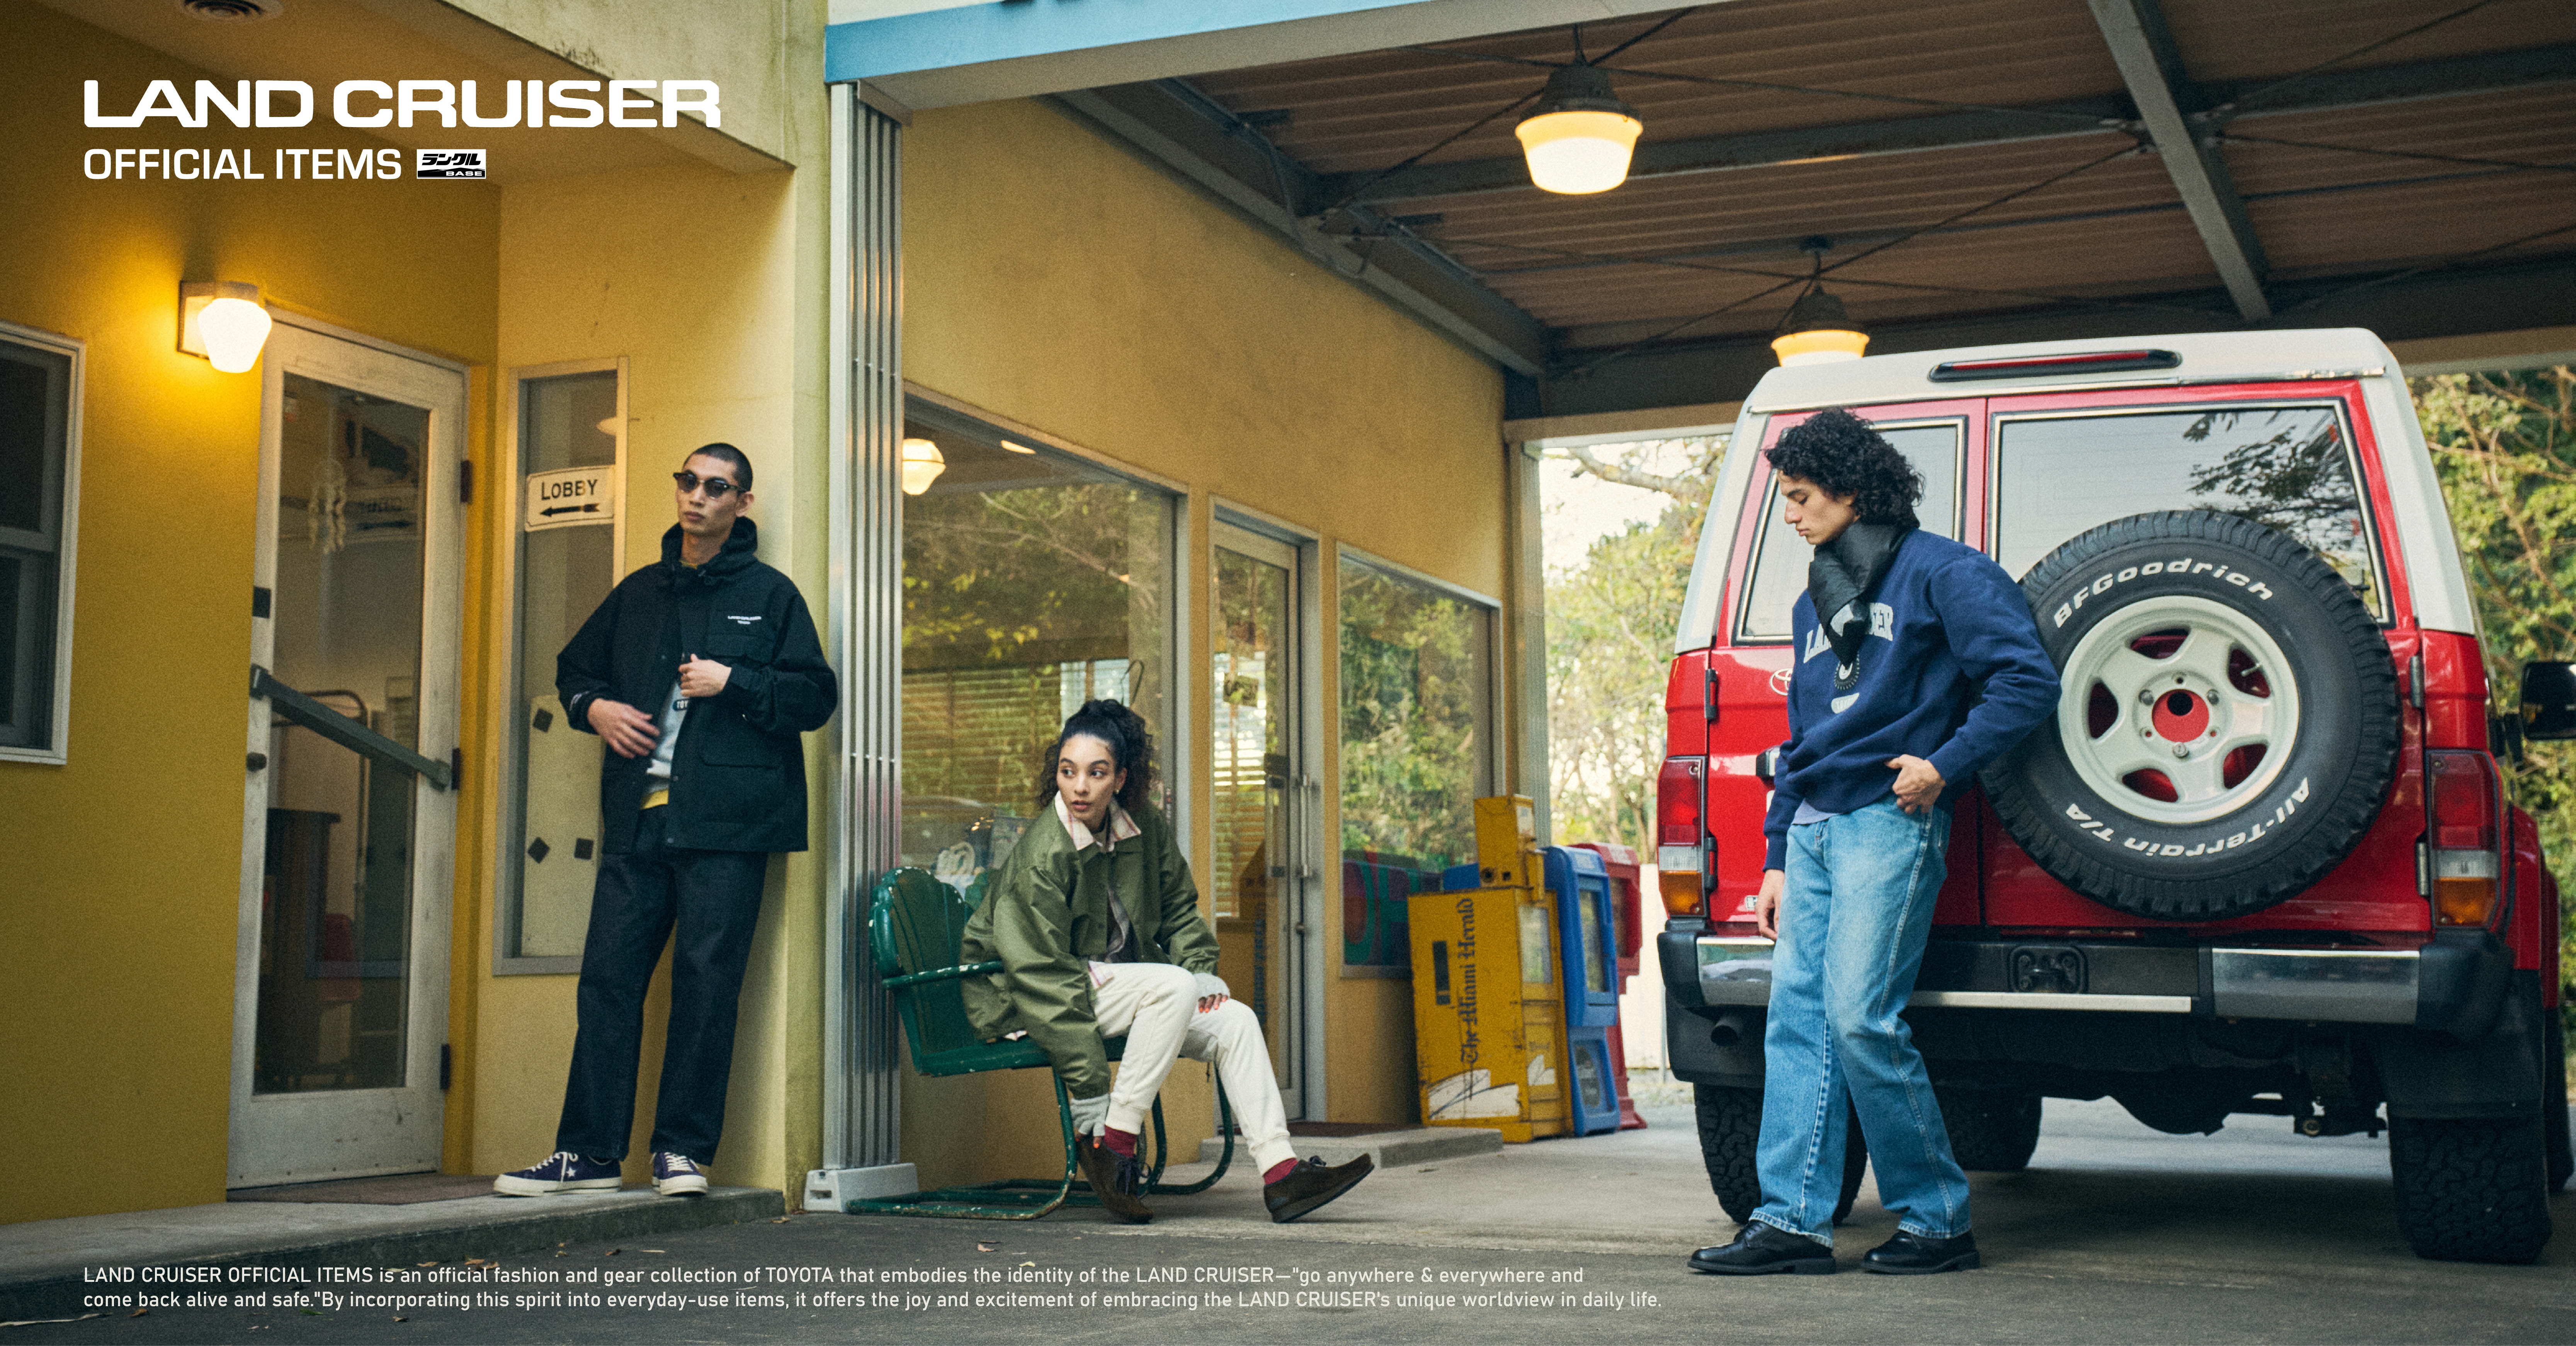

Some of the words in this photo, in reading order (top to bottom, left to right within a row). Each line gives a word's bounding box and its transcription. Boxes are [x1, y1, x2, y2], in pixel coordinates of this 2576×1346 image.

[541, 479, 598, 501] LOBBY
[2053, 558, 2273, 629] BFGoodrich
[2065, 803, 2114, 842] T/A
[2123, 777, 2309, 857] All-Terrain
[1456, 897, 1476, 960] Herald
[1458, 964, 1478, 1026] Miami
[1460, 1029, 1481, 1064] The
